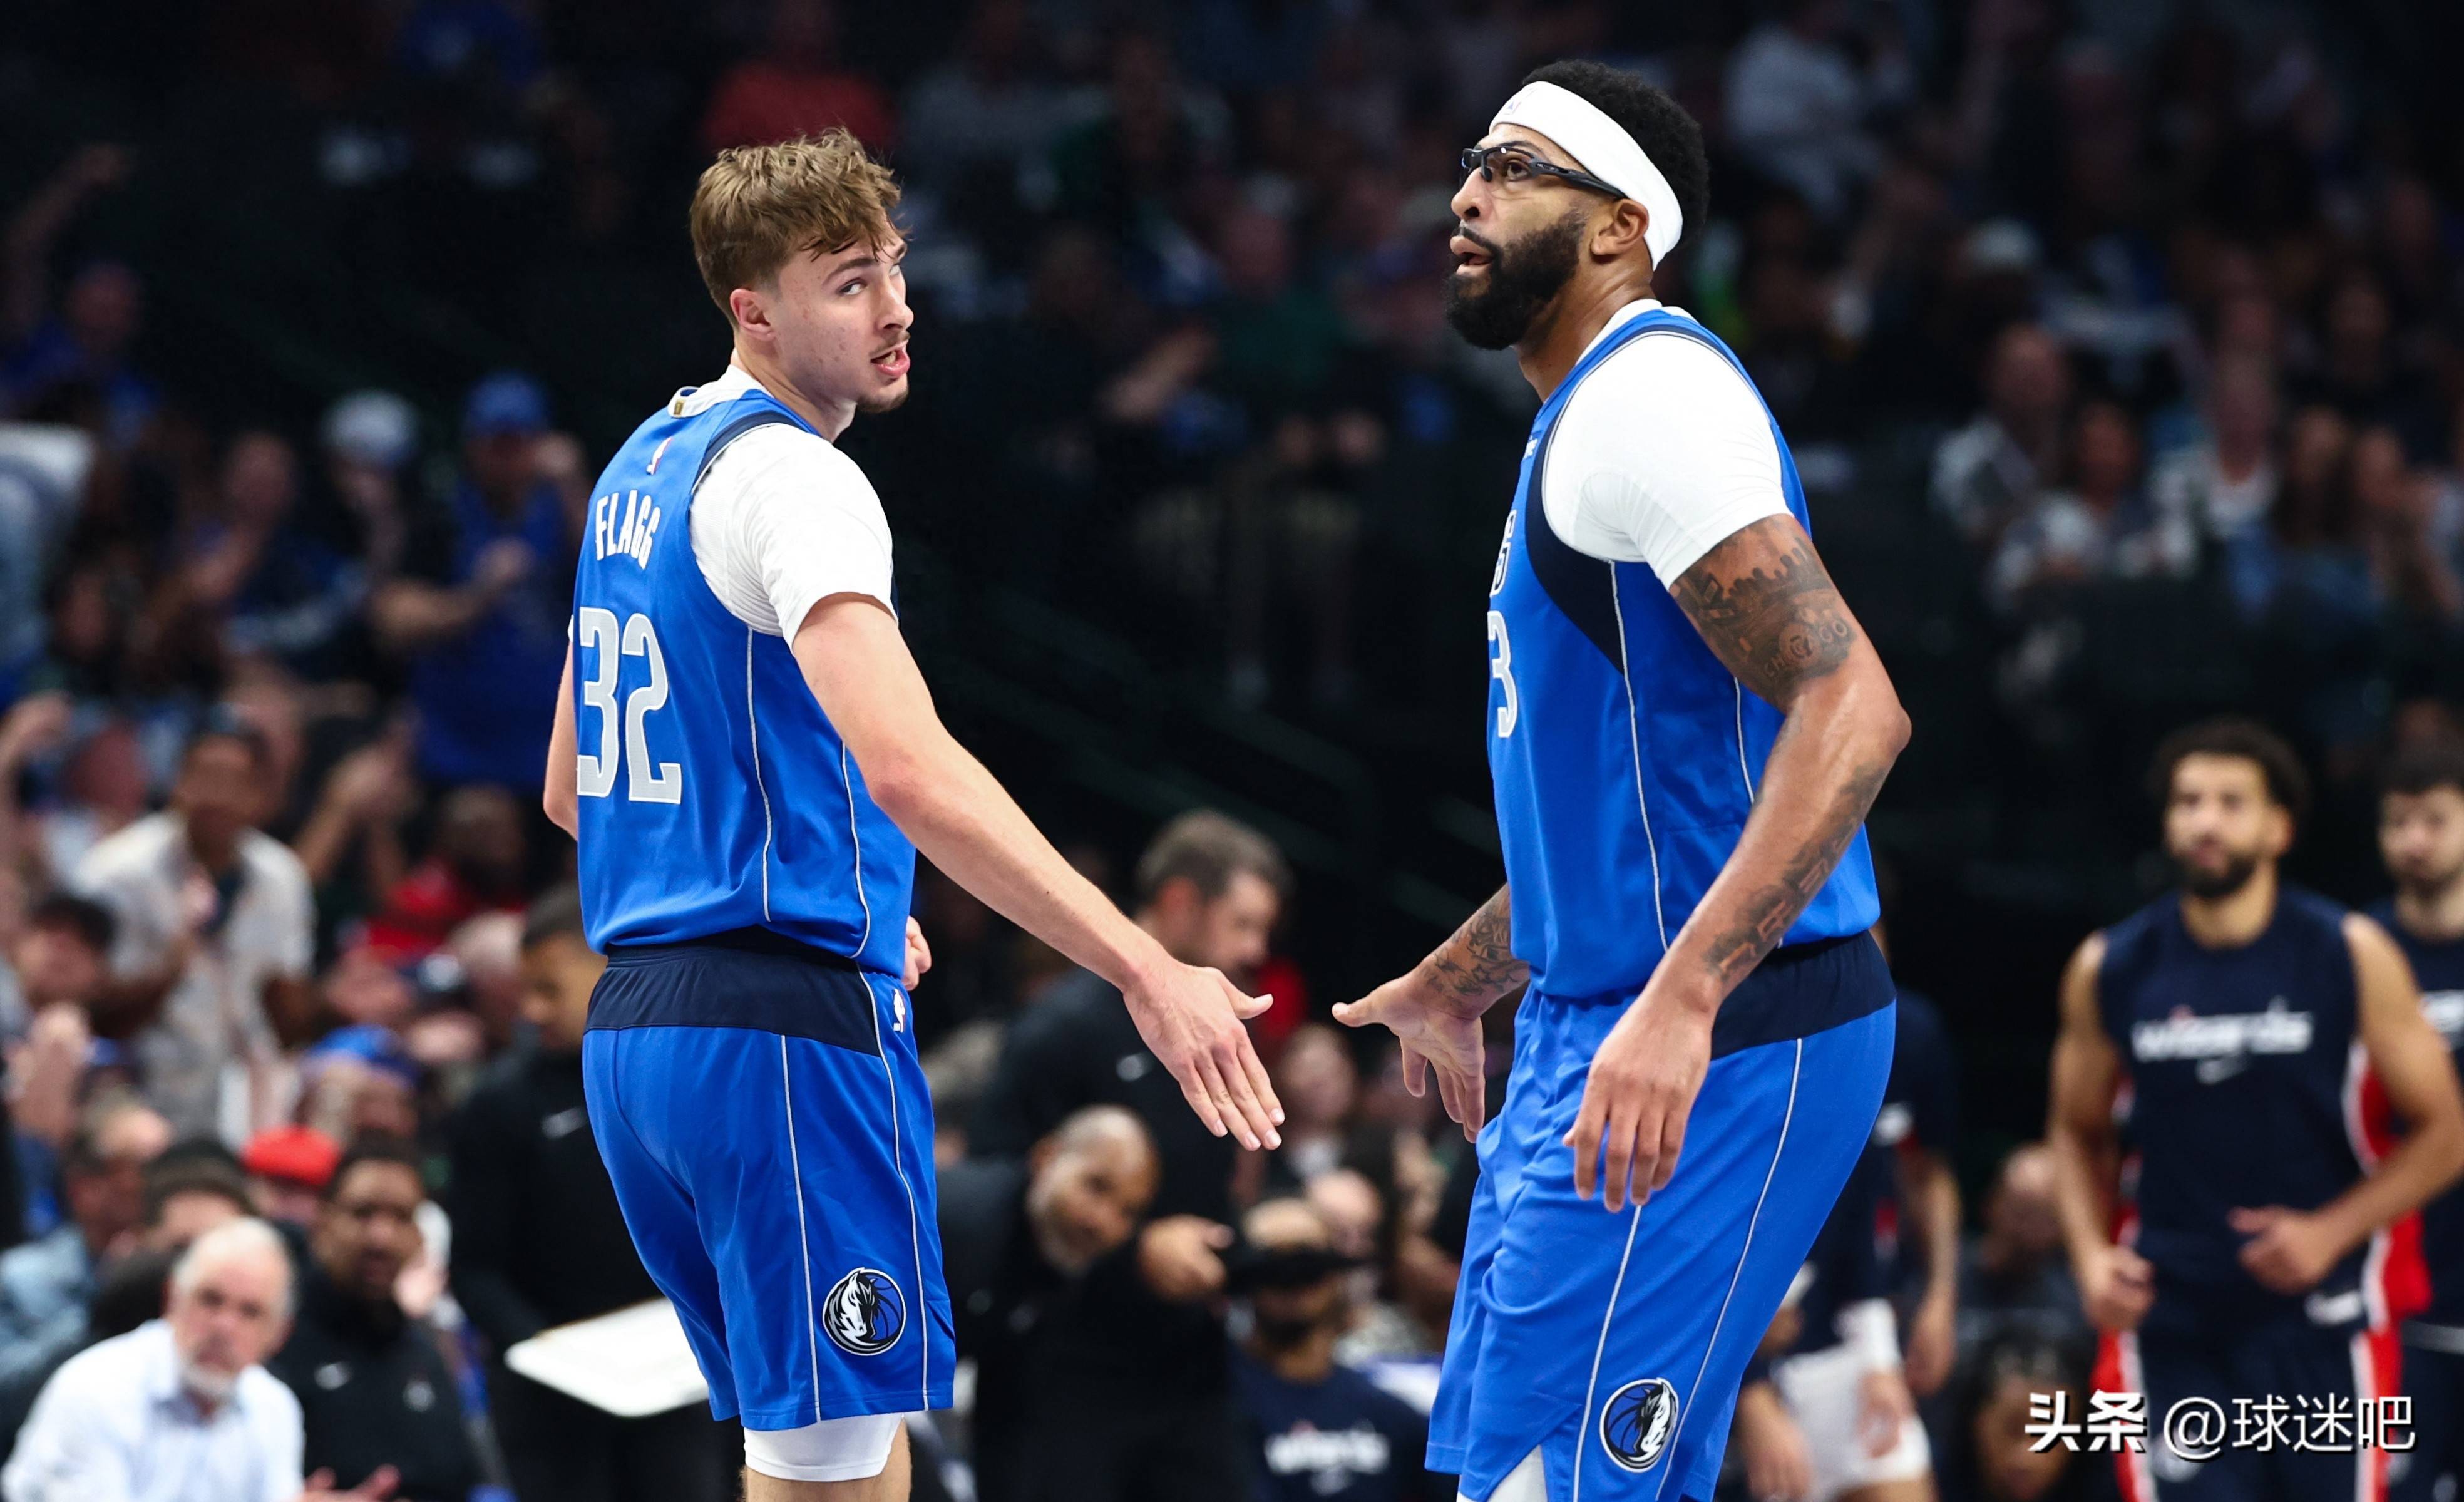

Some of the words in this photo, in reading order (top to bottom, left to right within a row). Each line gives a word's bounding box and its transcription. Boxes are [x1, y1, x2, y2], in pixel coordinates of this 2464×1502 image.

[595, 486, 661, 570] FLAGG
[577, 606, 682, 805] 32
[1487, 610, 1519, 738] 3
